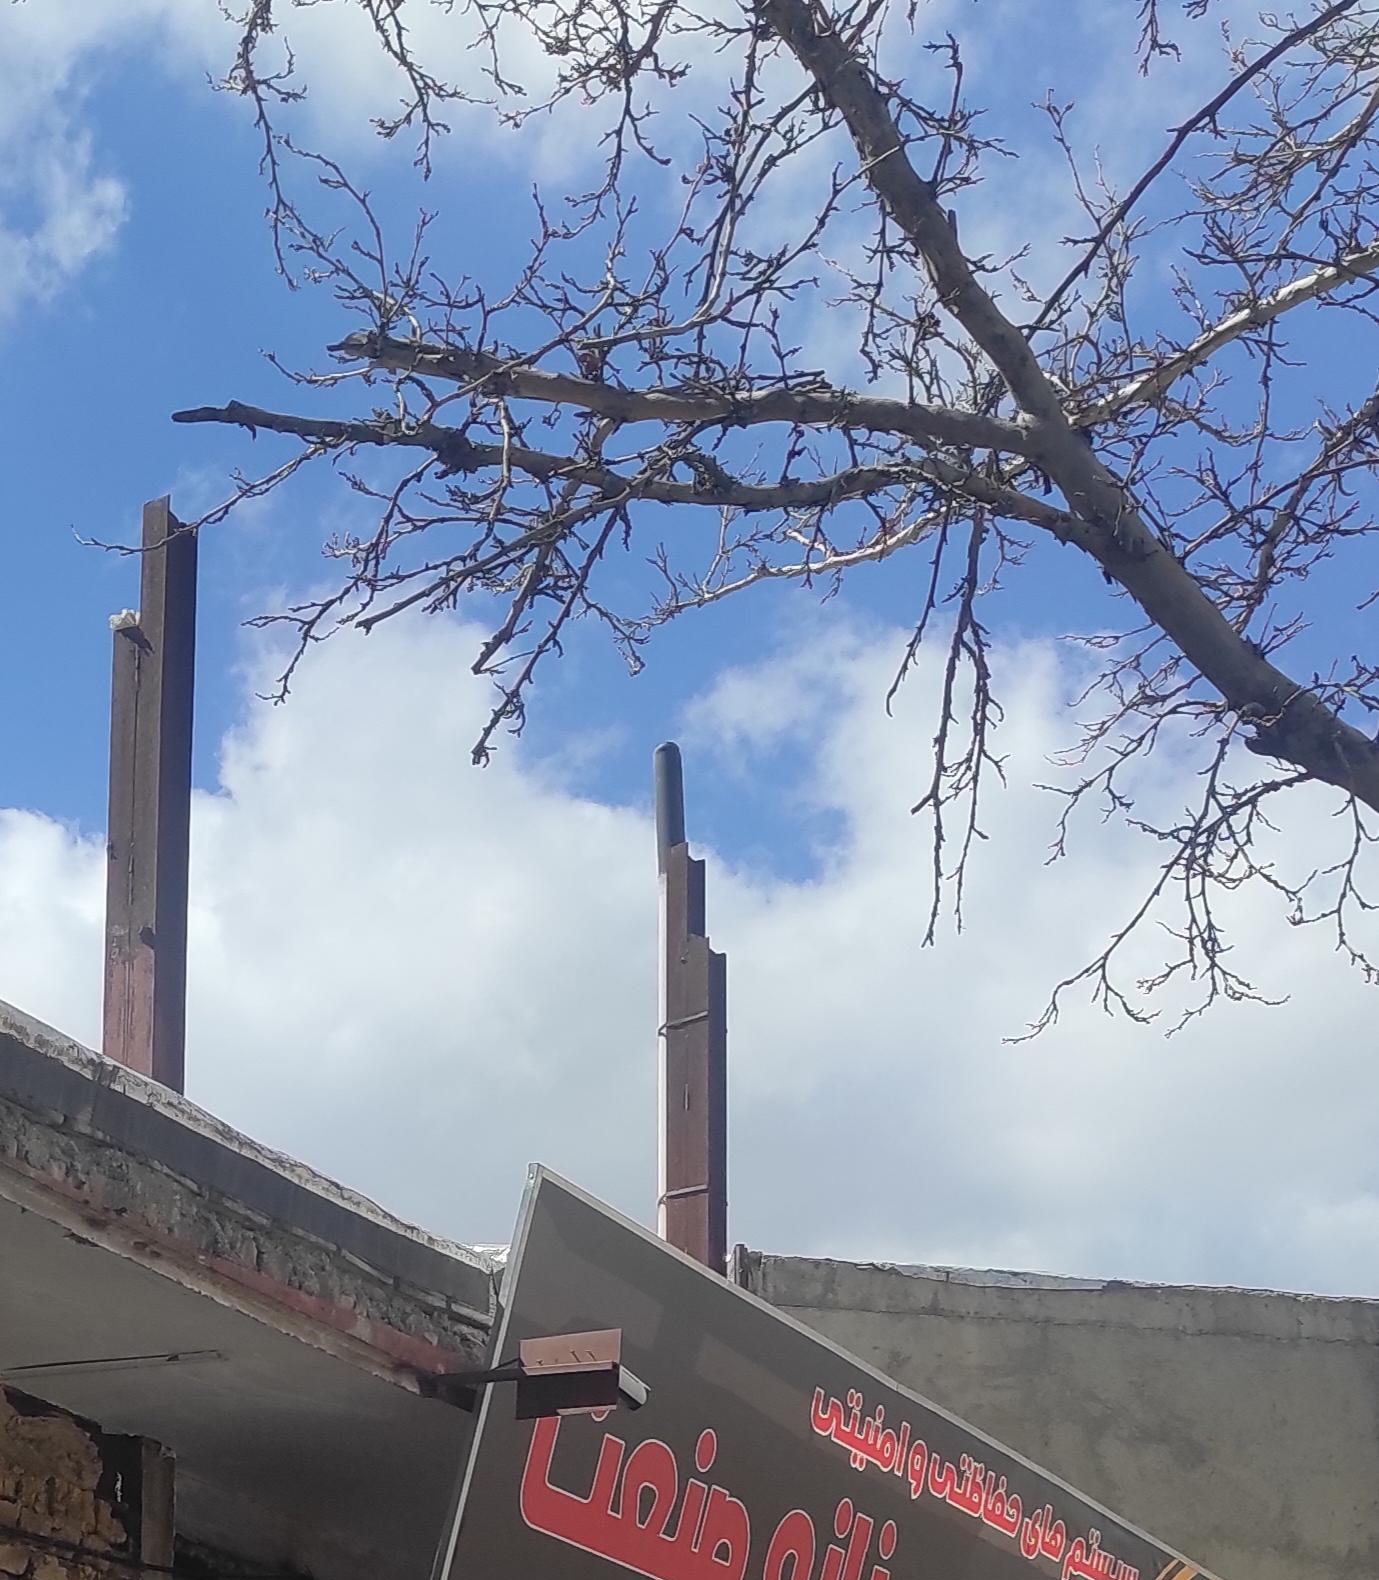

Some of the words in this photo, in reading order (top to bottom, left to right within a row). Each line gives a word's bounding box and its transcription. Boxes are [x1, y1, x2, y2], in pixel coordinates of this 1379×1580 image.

[810, 1386, 911, 1477] امنیتی
[908, 1440, 928, 1500] و
[928, 1452, 1022, 1538] حفاظتی
[1020, 1504, 1065, 1562] های
